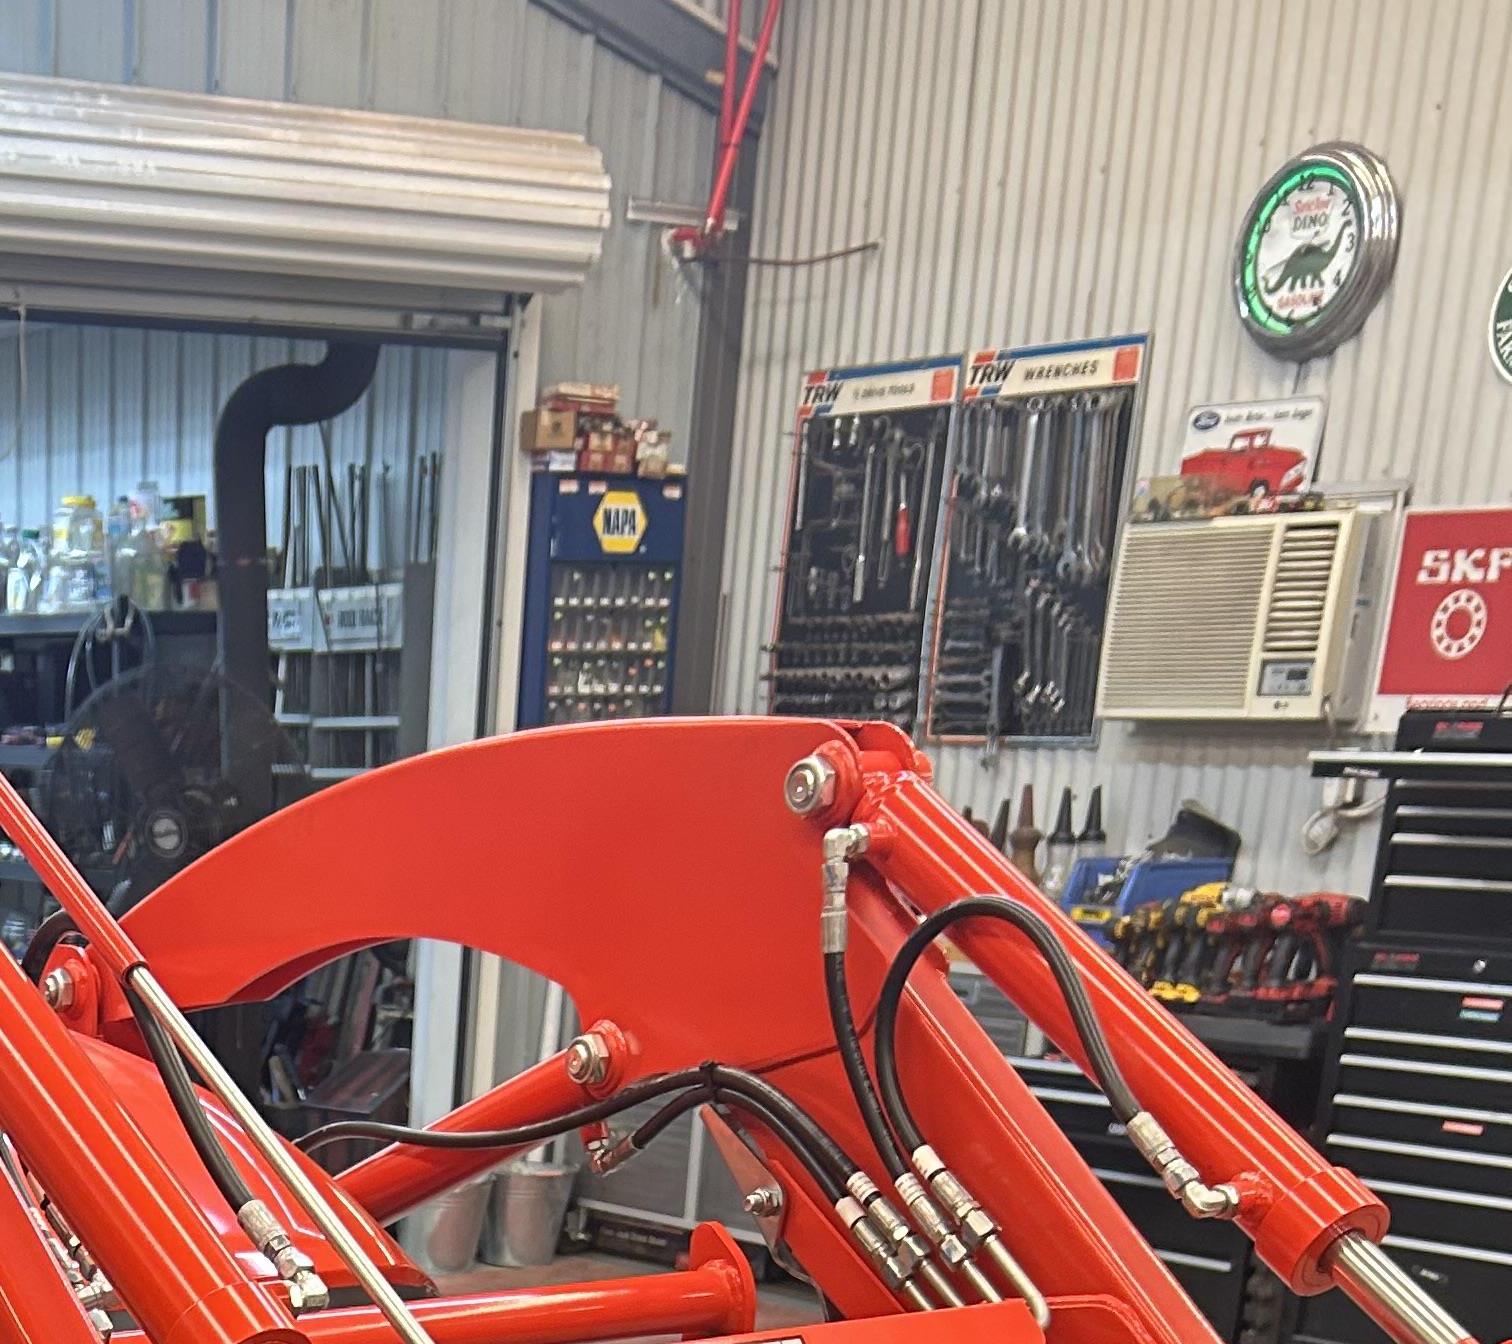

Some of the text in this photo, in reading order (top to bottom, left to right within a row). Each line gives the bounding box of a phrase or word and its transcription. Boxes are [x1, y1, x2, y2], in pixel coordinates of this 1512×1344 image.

[1293, 212, 1328, 232] DINO
[969, 358, 1100, 386] TRW WRENCHES
[803, 381, 844, 405] TRW
[603, 507, 637, 536] NAPA
[1416, 546, 1512, 585] SKF
